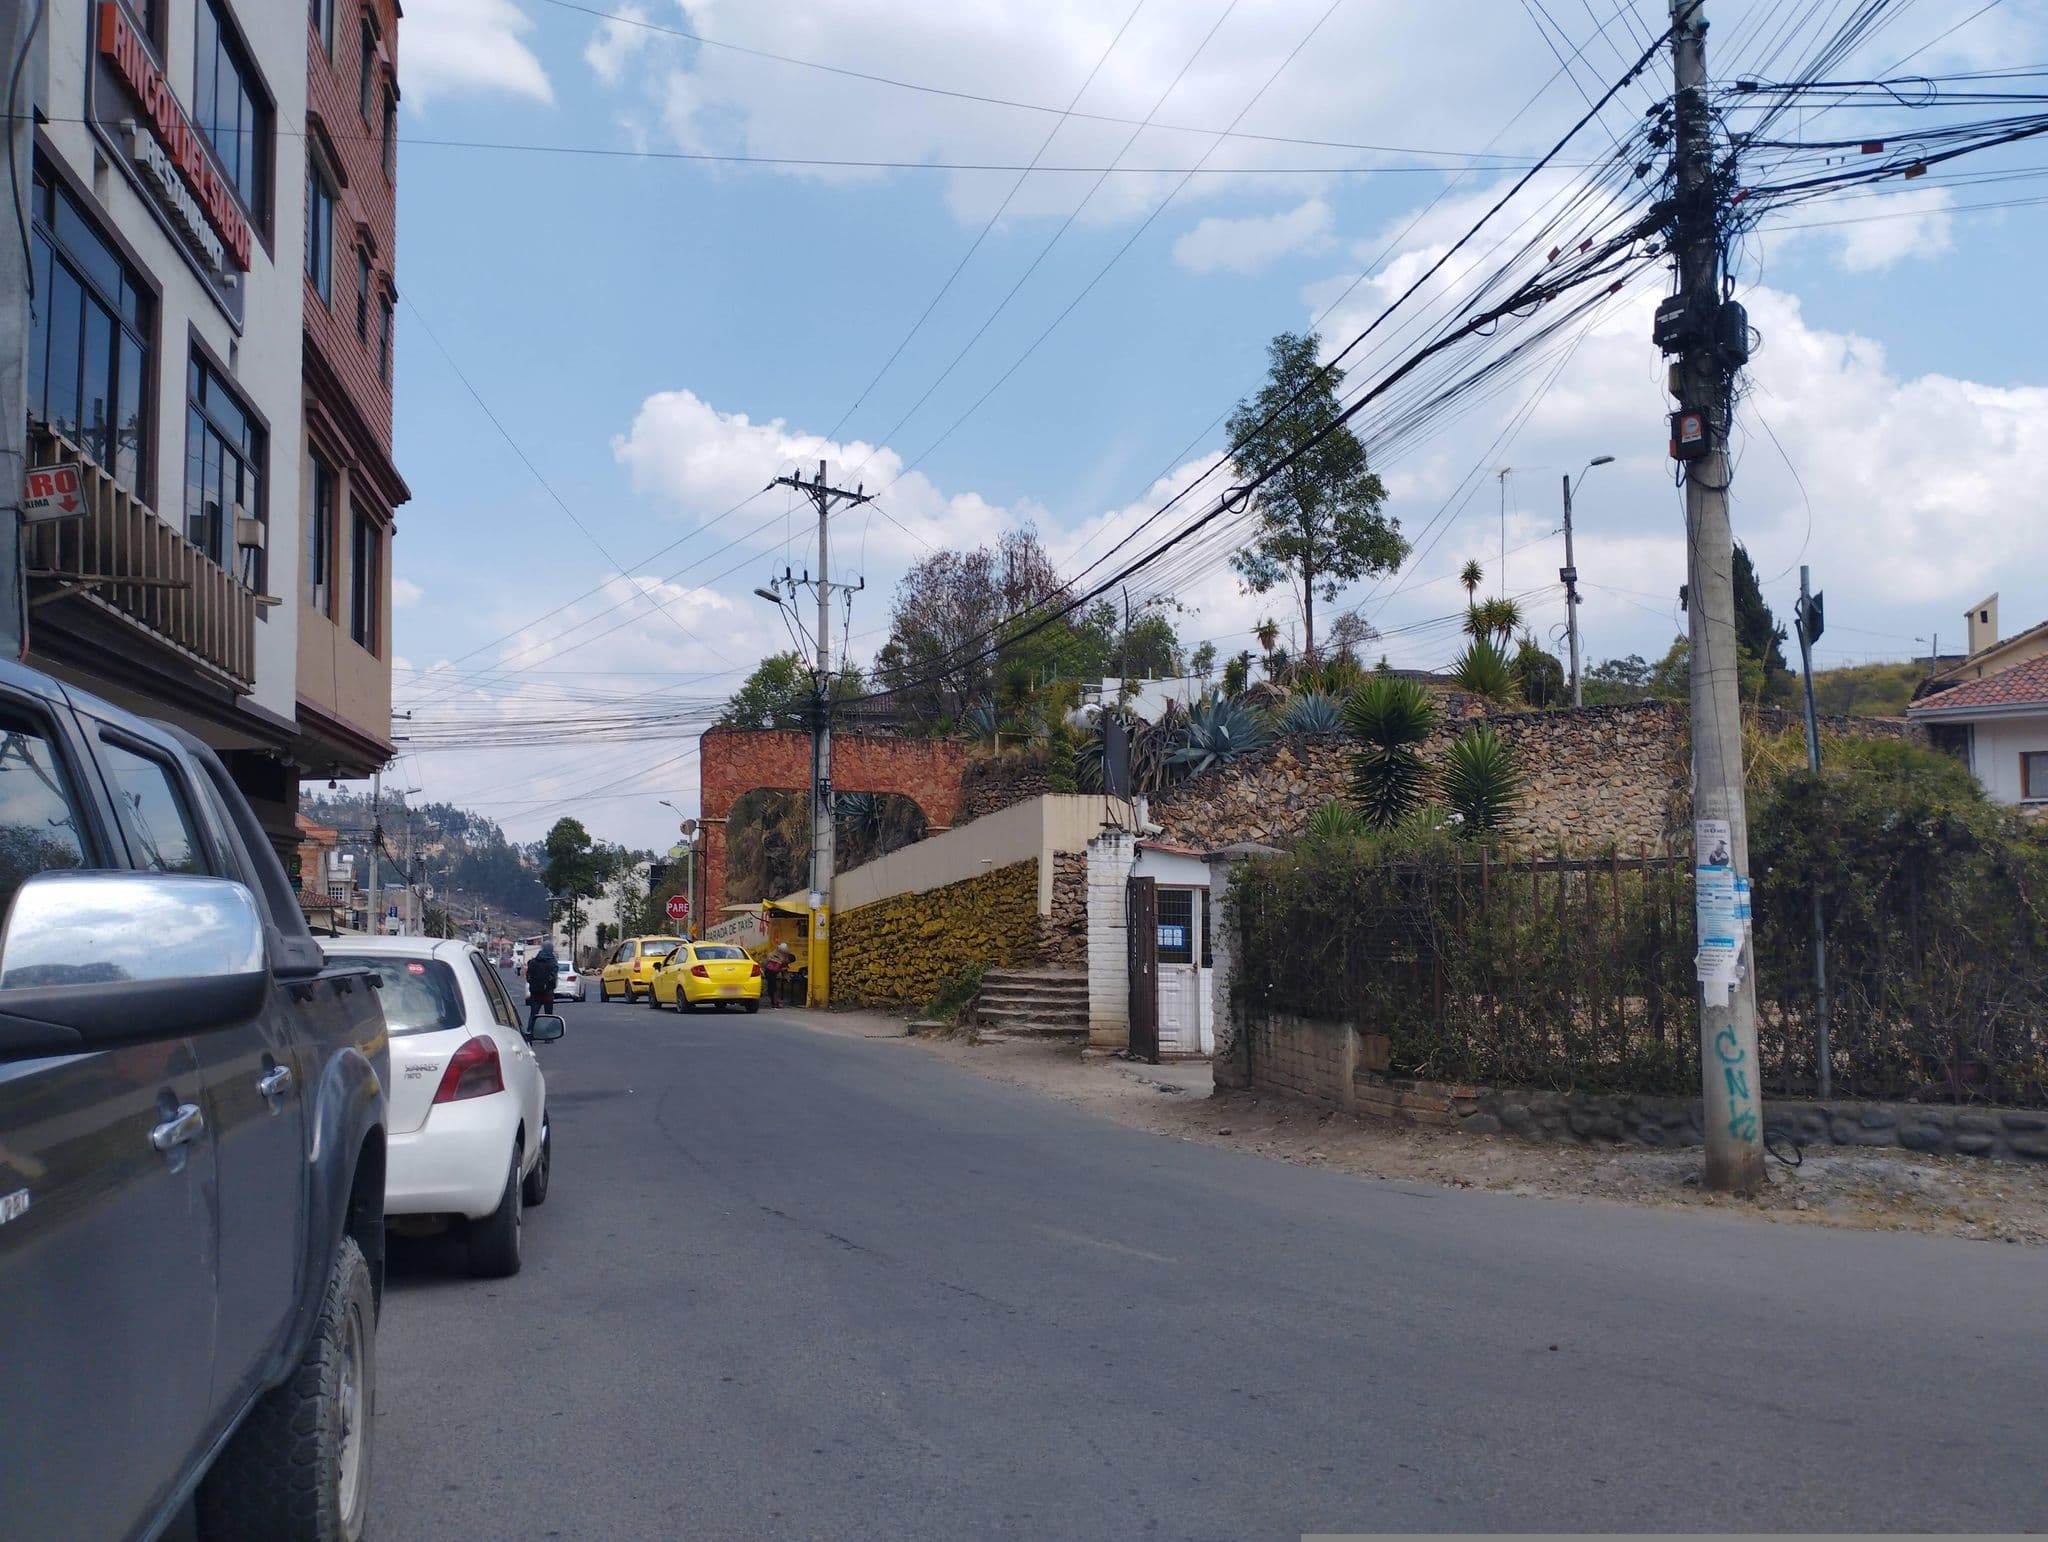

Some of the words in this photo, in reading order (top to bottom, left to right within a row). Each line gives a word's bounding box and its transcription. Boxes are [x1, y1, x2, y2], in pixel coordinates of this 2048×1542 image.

[182, 121, 208, 202] DEL
[209, 170, 251, 272] SABOR
[667, 903, 689, 913] PARE
